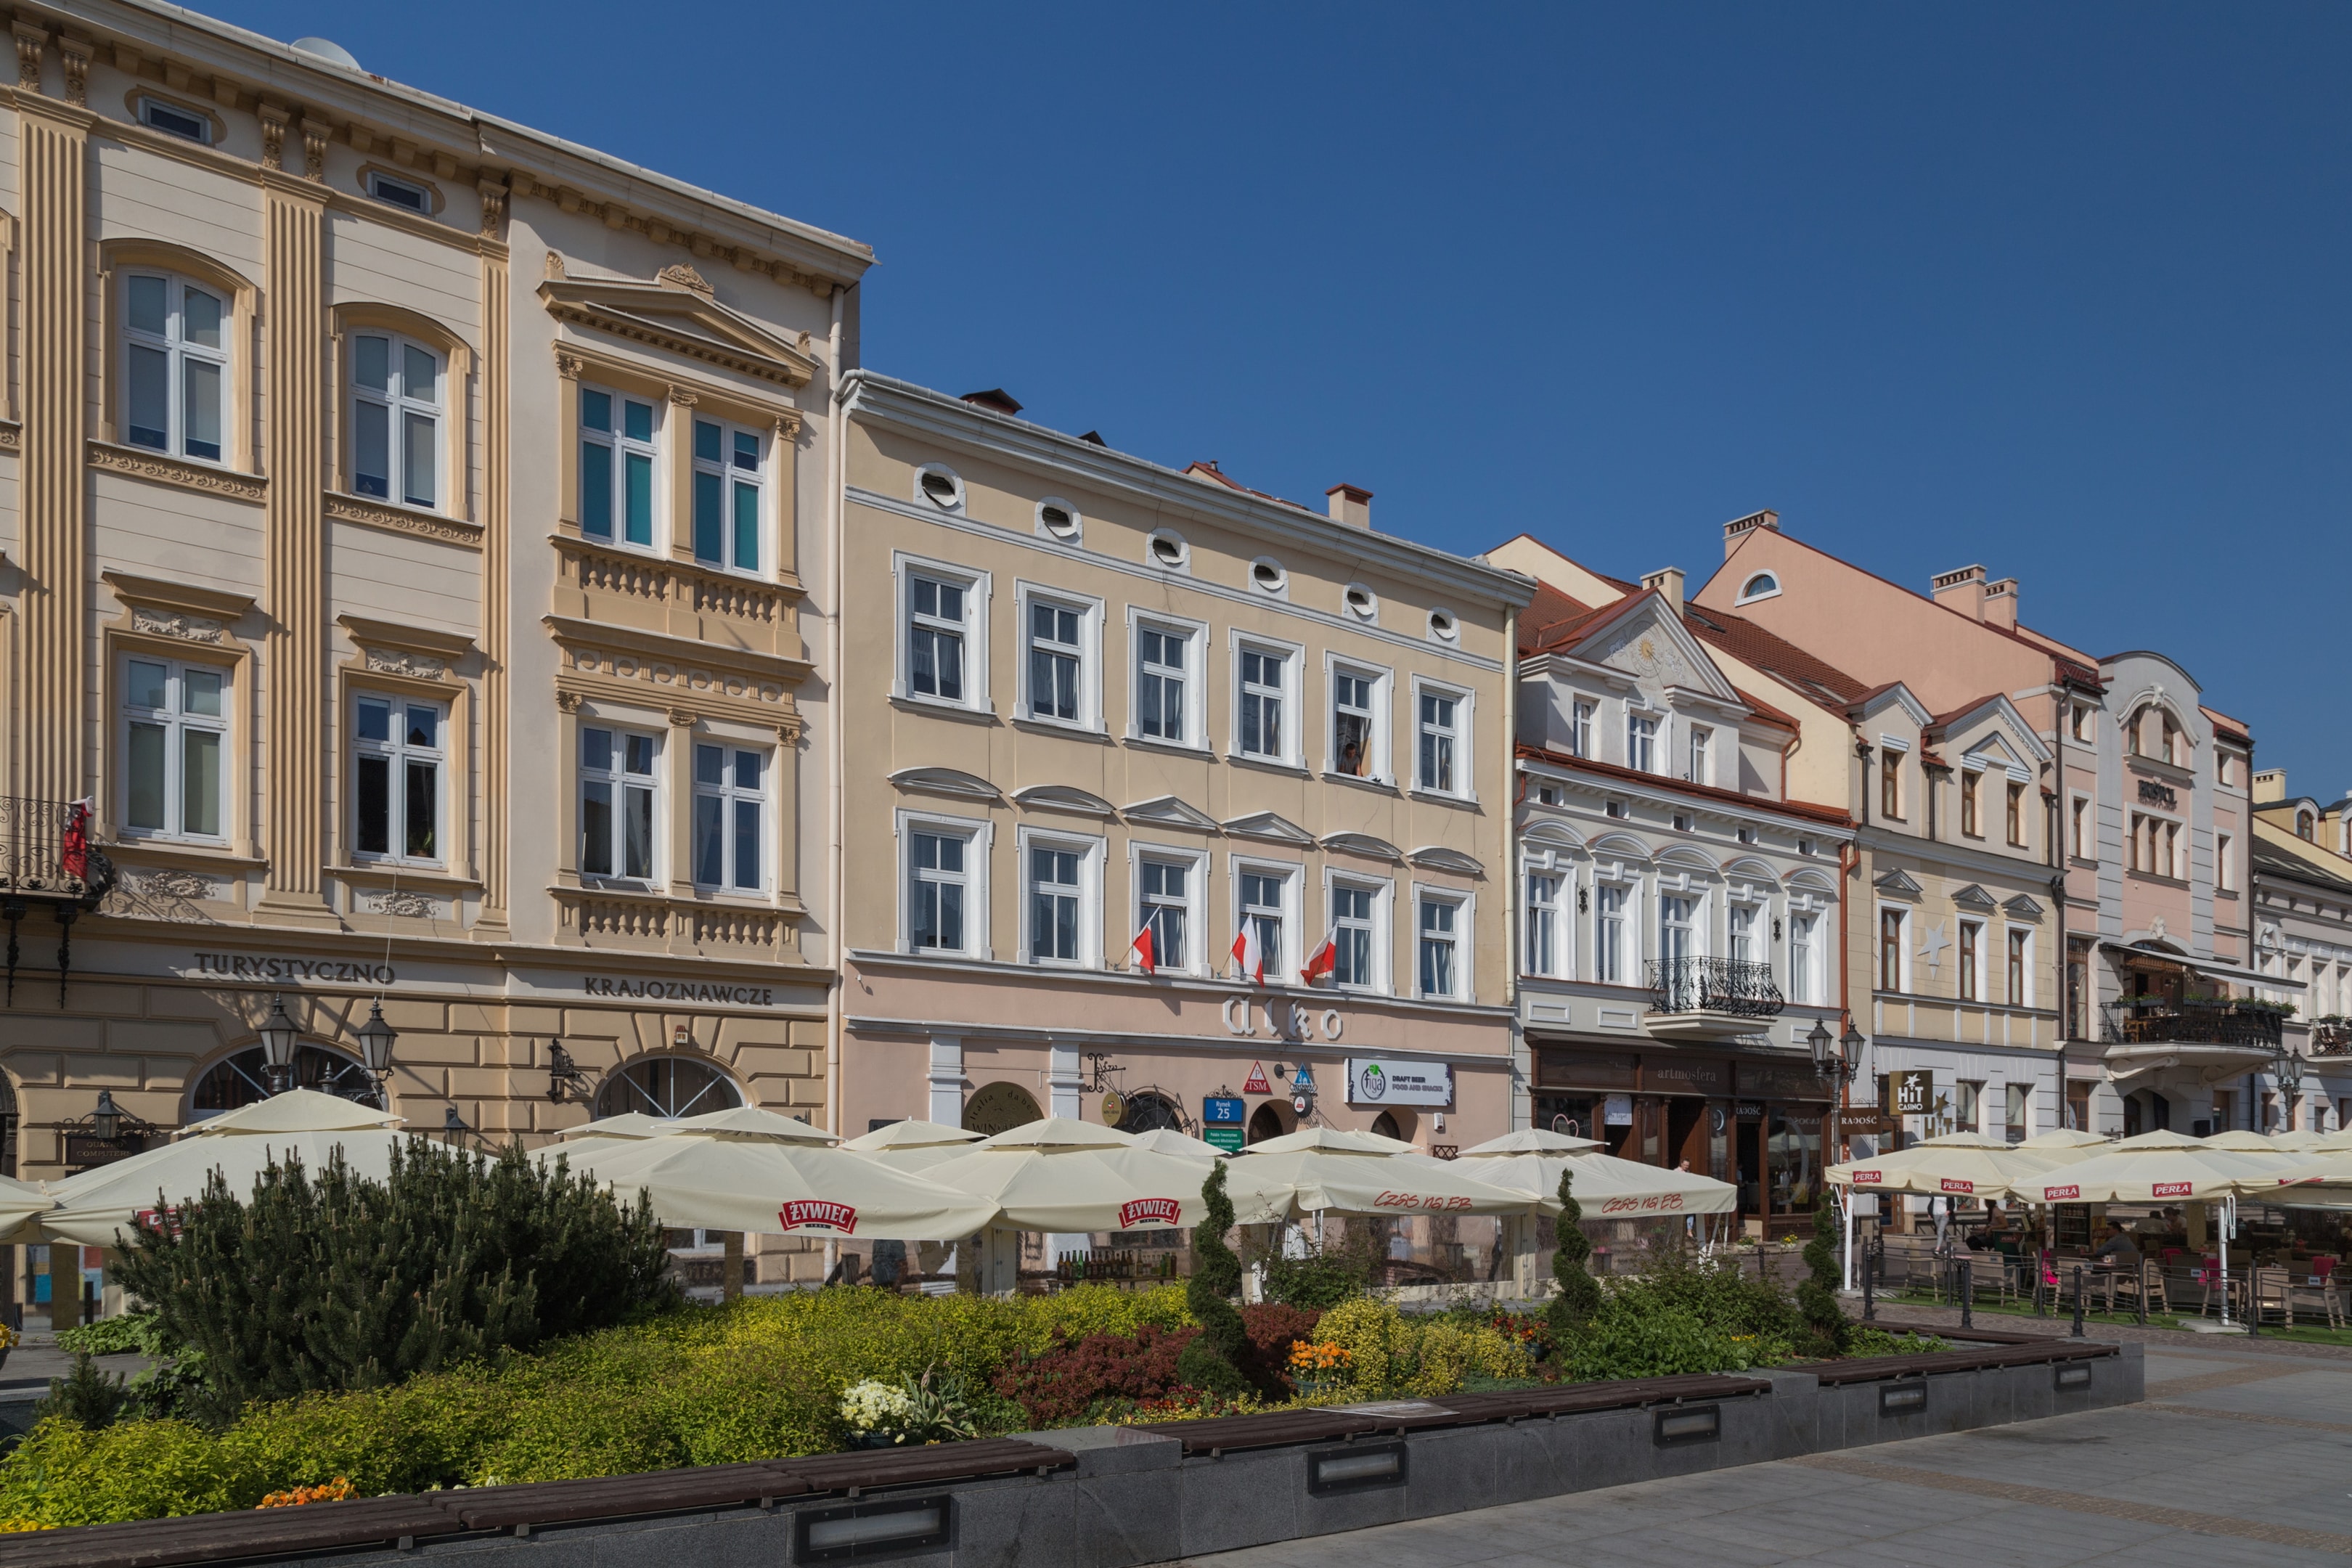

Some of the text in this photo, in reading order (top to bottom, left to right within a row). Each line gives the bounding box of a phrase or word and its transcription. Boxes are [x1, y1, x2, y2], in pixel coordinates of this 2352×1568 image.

[194, 952, 396, 985] TURYSTYCZNO
[584, 977, 773, 1006] KRAJOZNAWCZE
[1256, 1069, 1260, 1078] P
[1657, 1066, 1716, 1082] artmosfera
[1365, 1073, 1382, 1093] figa
[1217, 1108, 1230, 1119] 25
[1943, 1182, 1972, 1191] PERŁA
[2047, 1187, 2078, 1198] PERŁA
[2155, 1185, 2189, 1195] PERŁA
[1422, 1196, 1444, 1211] na
[1444, 1196, 1472, 1212] EB
[1641, 1197, 1658, 1209] na
[1660, 1193, 1683, 1209] EB
[789, 1201, 850, 1224] ŻYWIEC
[1127, 1201, 1175, 1219] ŻYWIEC
